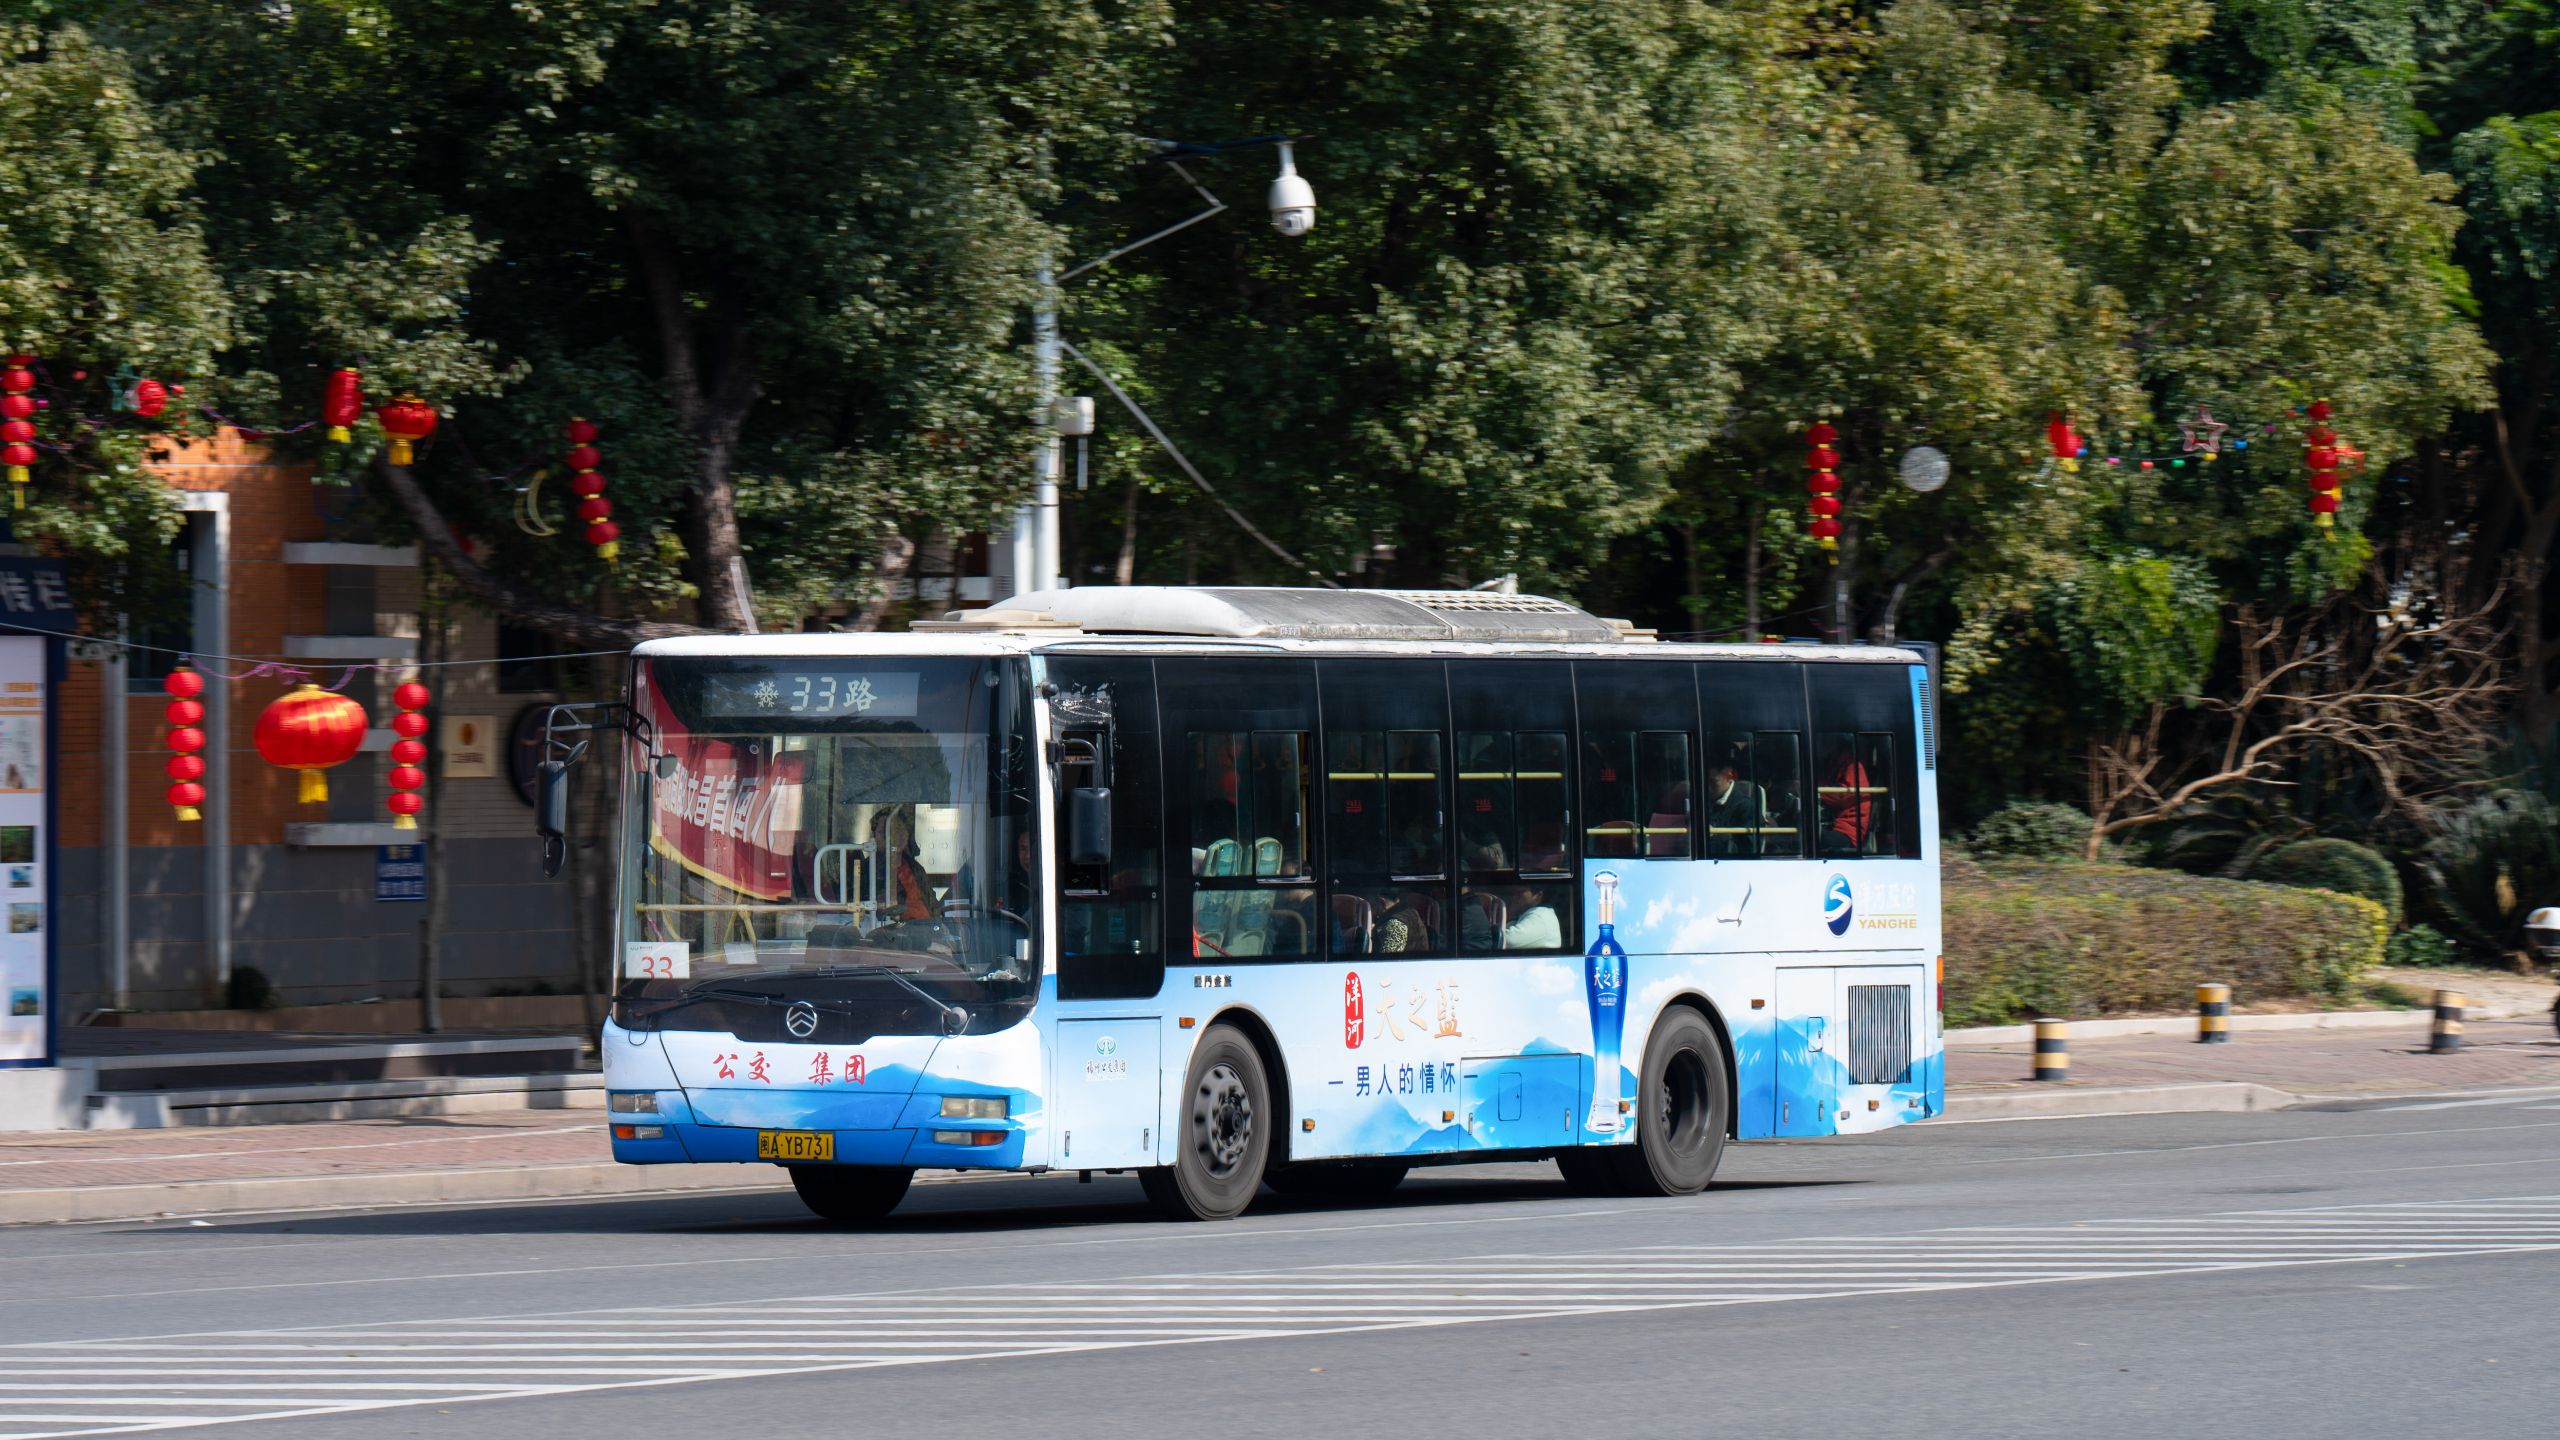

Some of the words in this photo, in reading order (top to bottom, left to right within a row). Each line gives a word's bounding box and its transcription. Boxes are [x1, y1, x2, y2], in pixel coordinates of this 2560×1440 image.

[790, 676, 878, 712] 33路
[1858, 919, 1918, 929] YANGHE
[641, 956, 673, 980] 33
[1345, 976, 1363, 1047] 洋河
